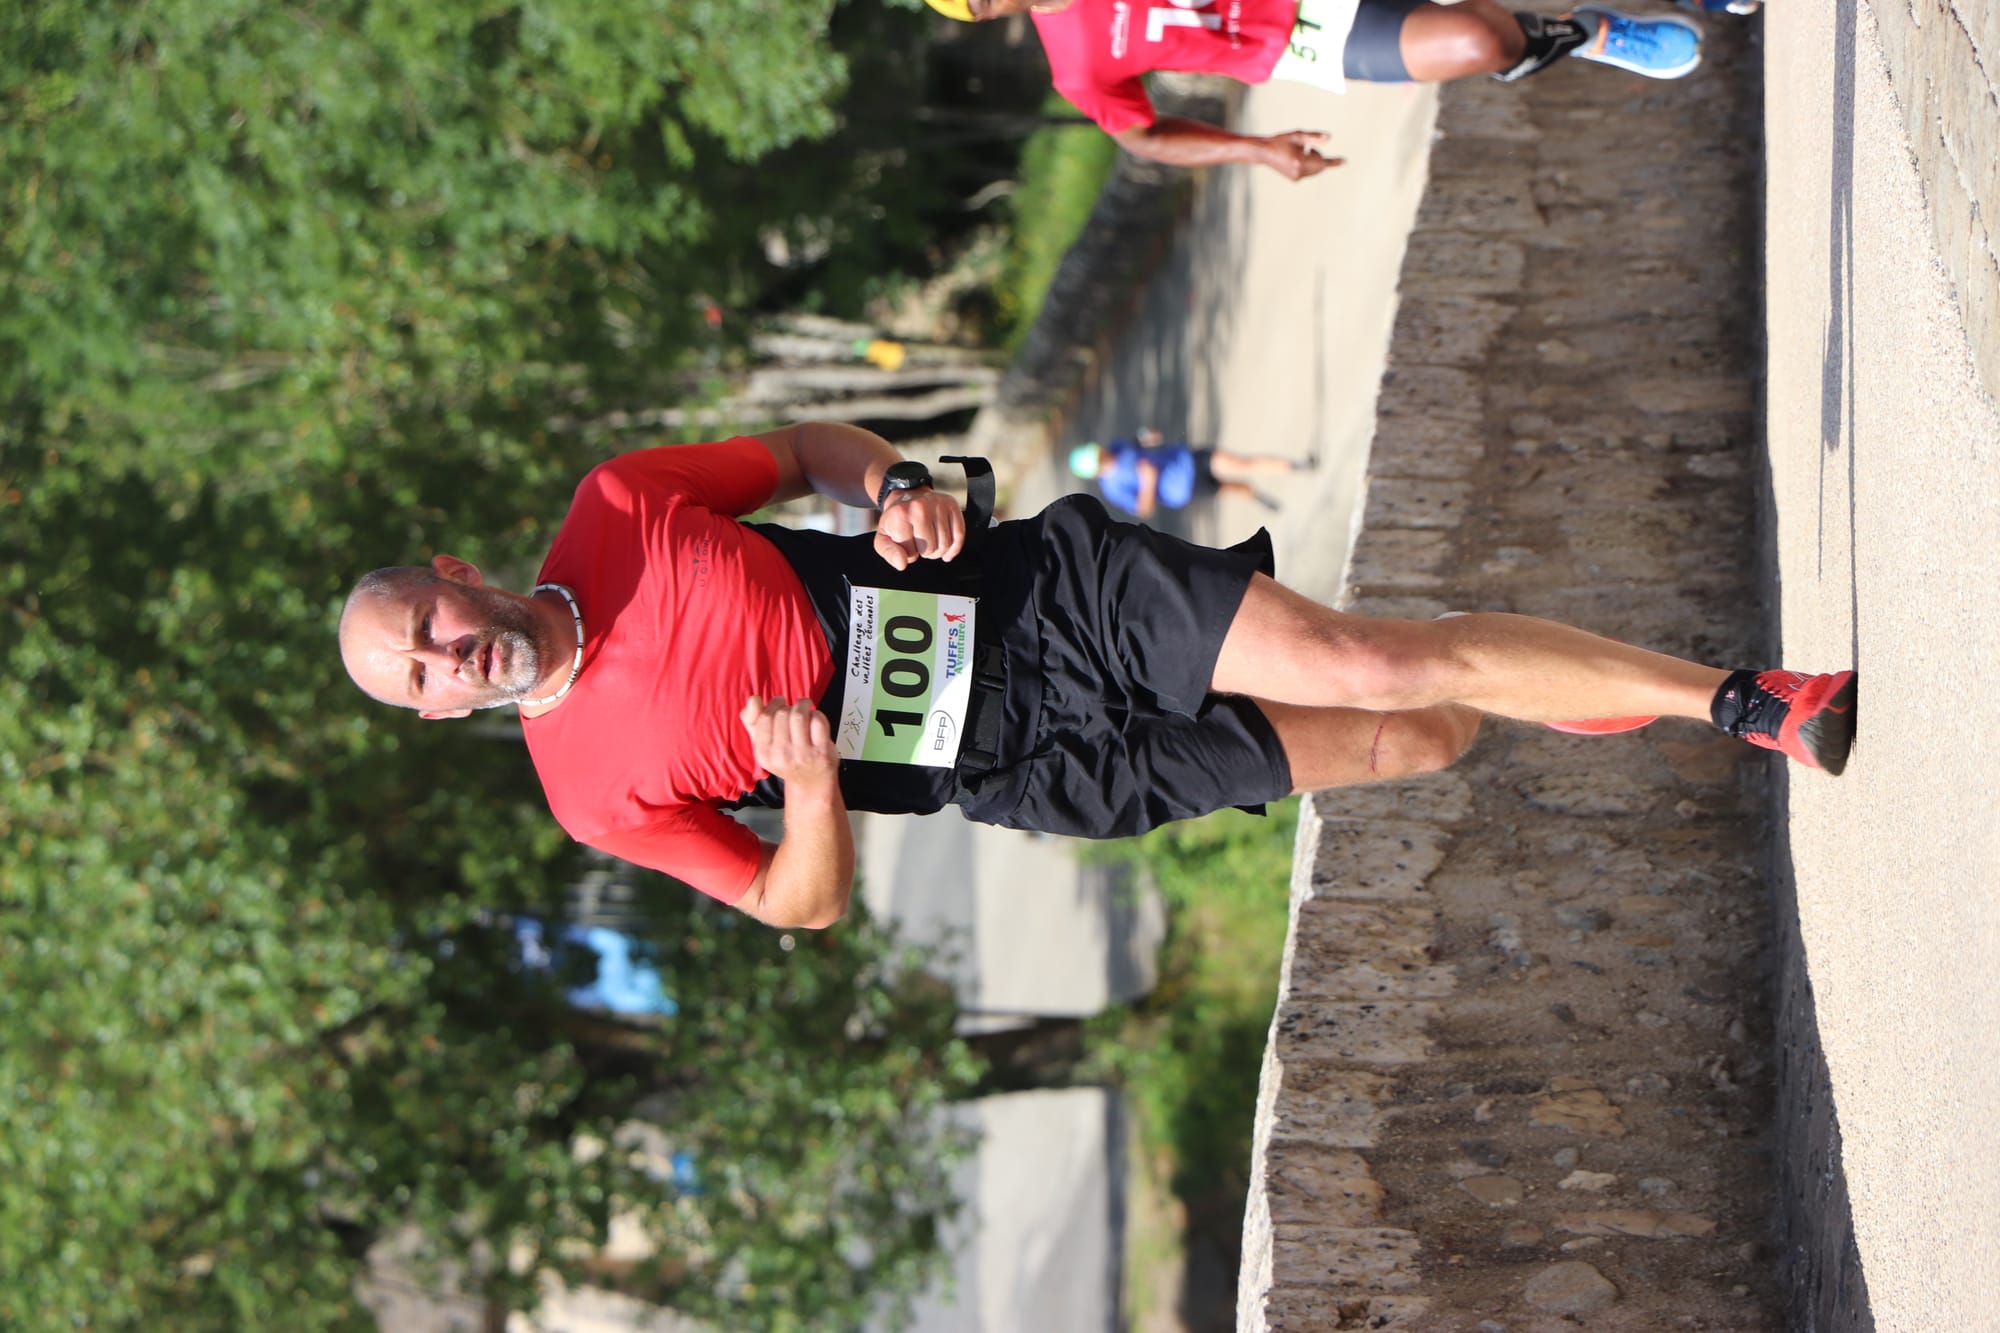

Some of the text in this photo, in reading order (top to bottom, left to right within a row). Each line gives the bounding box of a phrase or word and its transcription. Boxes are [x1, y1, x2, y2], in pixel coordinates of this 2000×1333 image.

[851, 624, 867, 677] Challenge
[946, 627, 959, 679] TUFF'S
[954, 623, 966, 675] Aventure
[875, 615, 933, 737] 100
[934, 716, 948, 751] BFP
